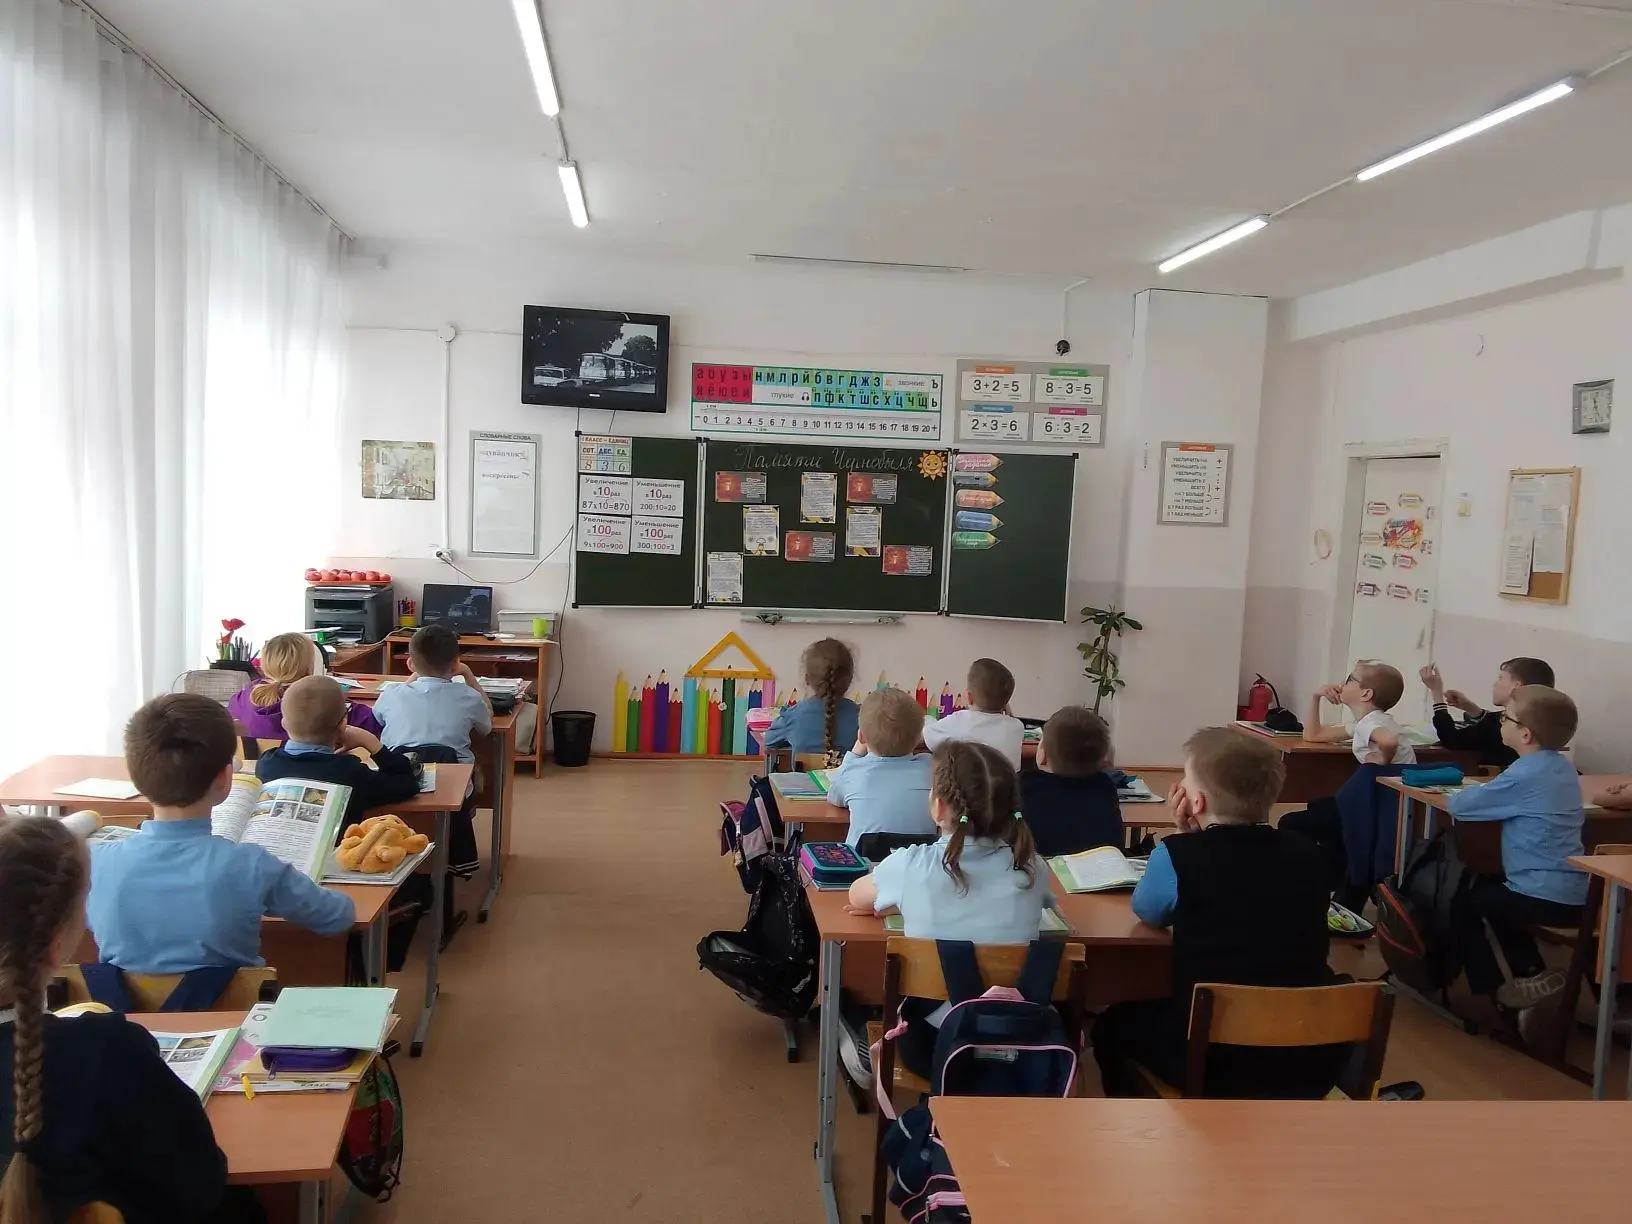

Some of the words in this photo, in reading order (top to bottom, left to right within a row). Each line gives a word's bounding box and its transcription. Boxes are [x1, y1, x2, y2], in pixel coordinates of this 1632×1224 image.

[735, 444, 824, 470] Памяти
[832, 448, 913, 472] Чернобыля
[585, 460, 592, 470] 8
[602, 460, 608, 471] 3
[619, 463, 625, 472] 6
[598, 487, 611, 496] 10
[650, 489, 662, 498] 10
[634, 520, 680, 528] Уменьшение
[592, 525, 611, 534] 100
[645, 529, 664, 538] 100
